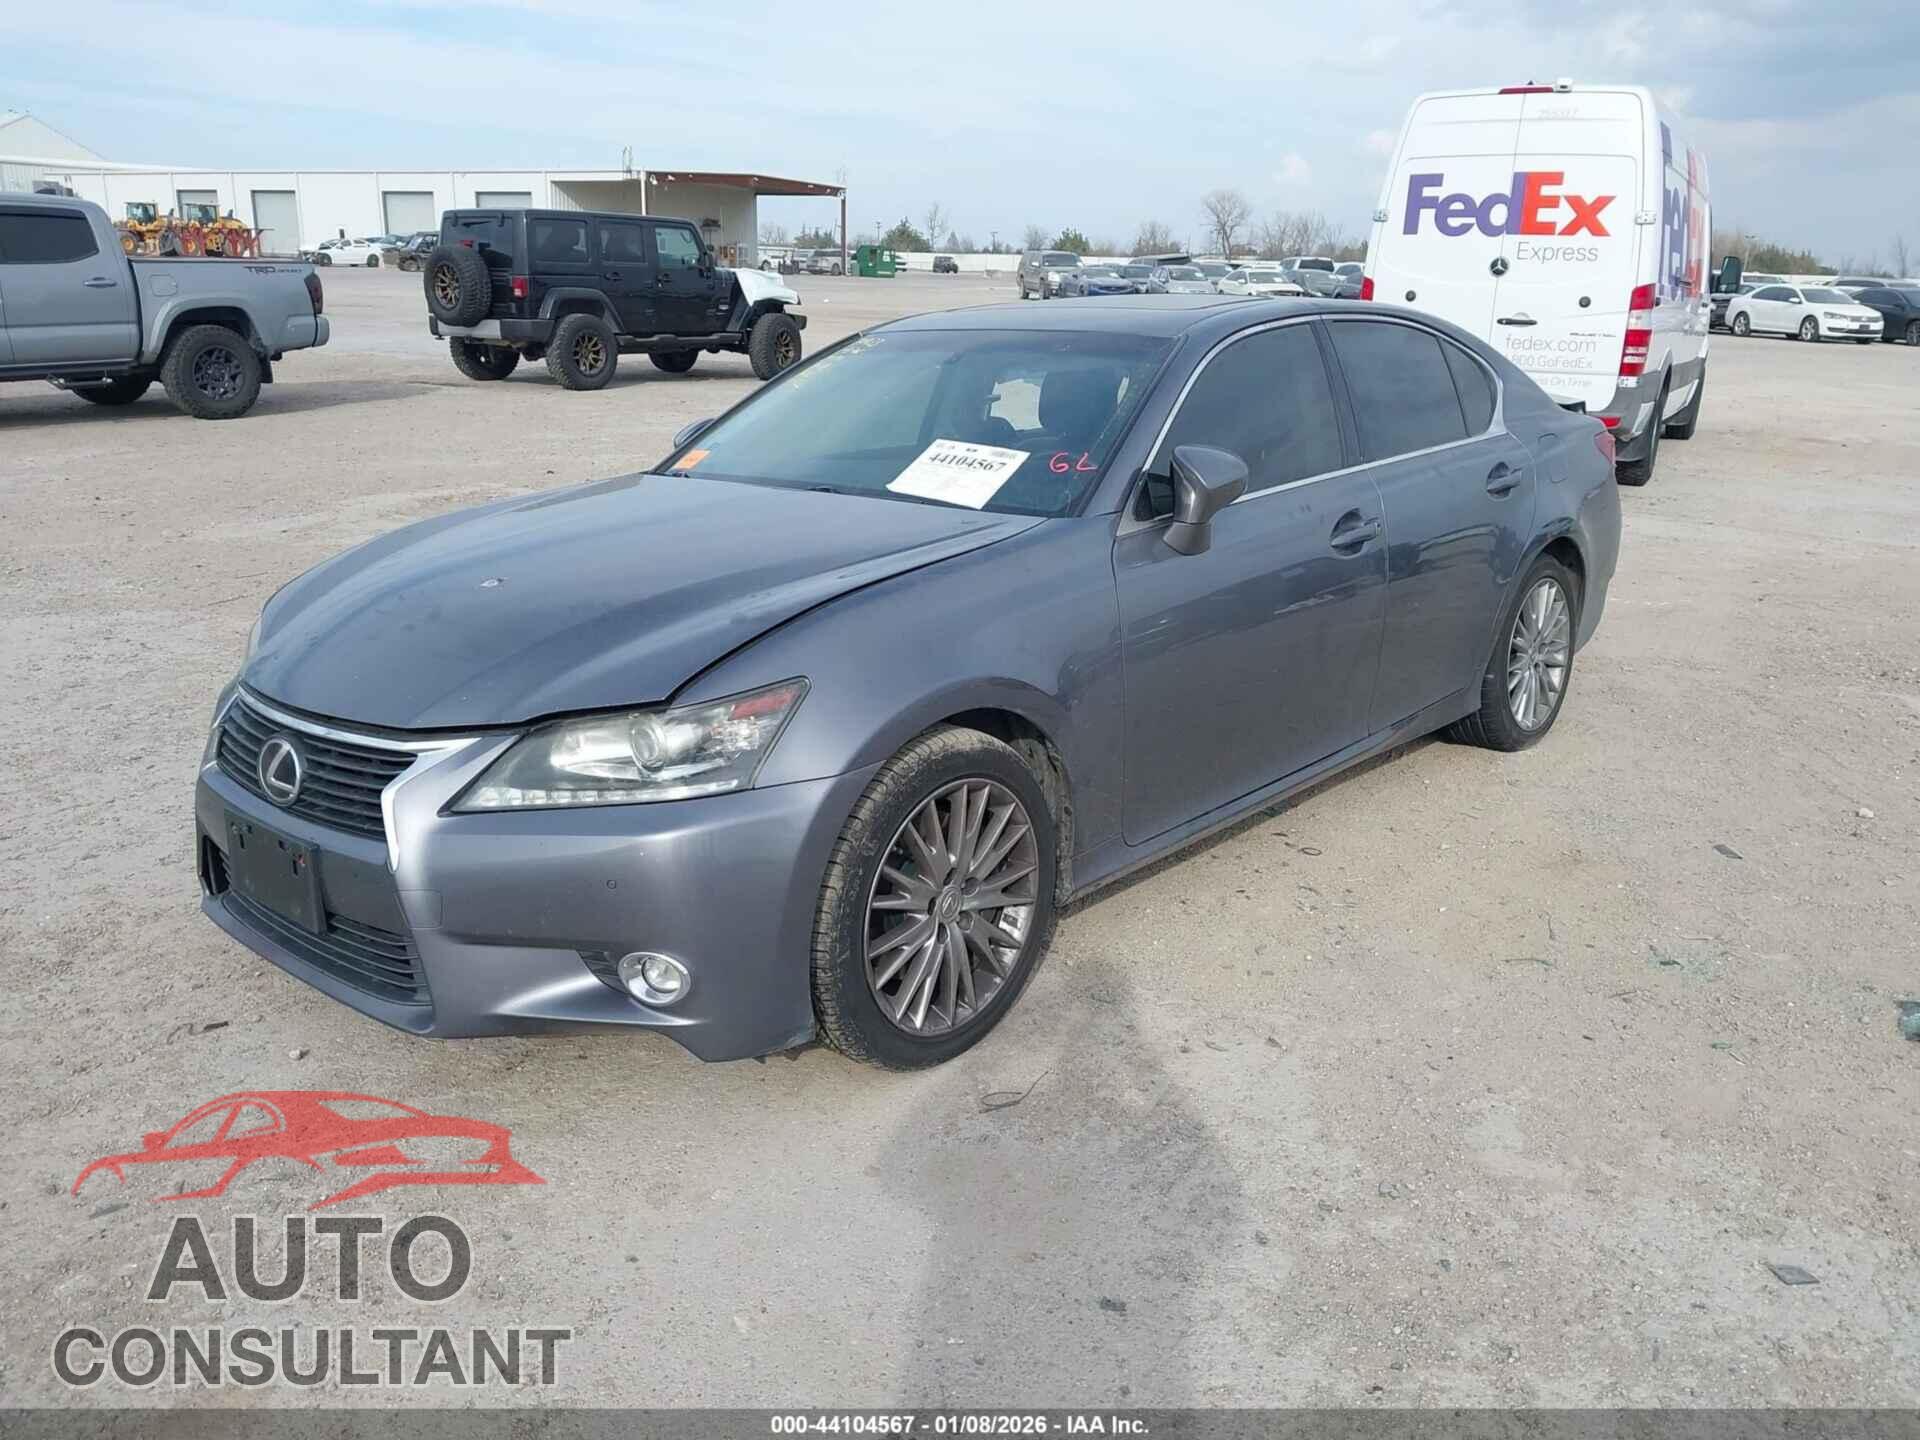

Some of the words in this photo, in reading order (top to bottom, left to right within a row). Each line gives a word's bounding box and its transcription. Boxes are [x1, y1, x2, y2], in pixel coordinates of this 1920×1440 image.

[1403, 171, 1616, 237] FedEx
[1516, 242, 1599, 262] Express
[1505, 334, 1597, 353] fedex.com
[929, 452, 1007, 472] 44104567
